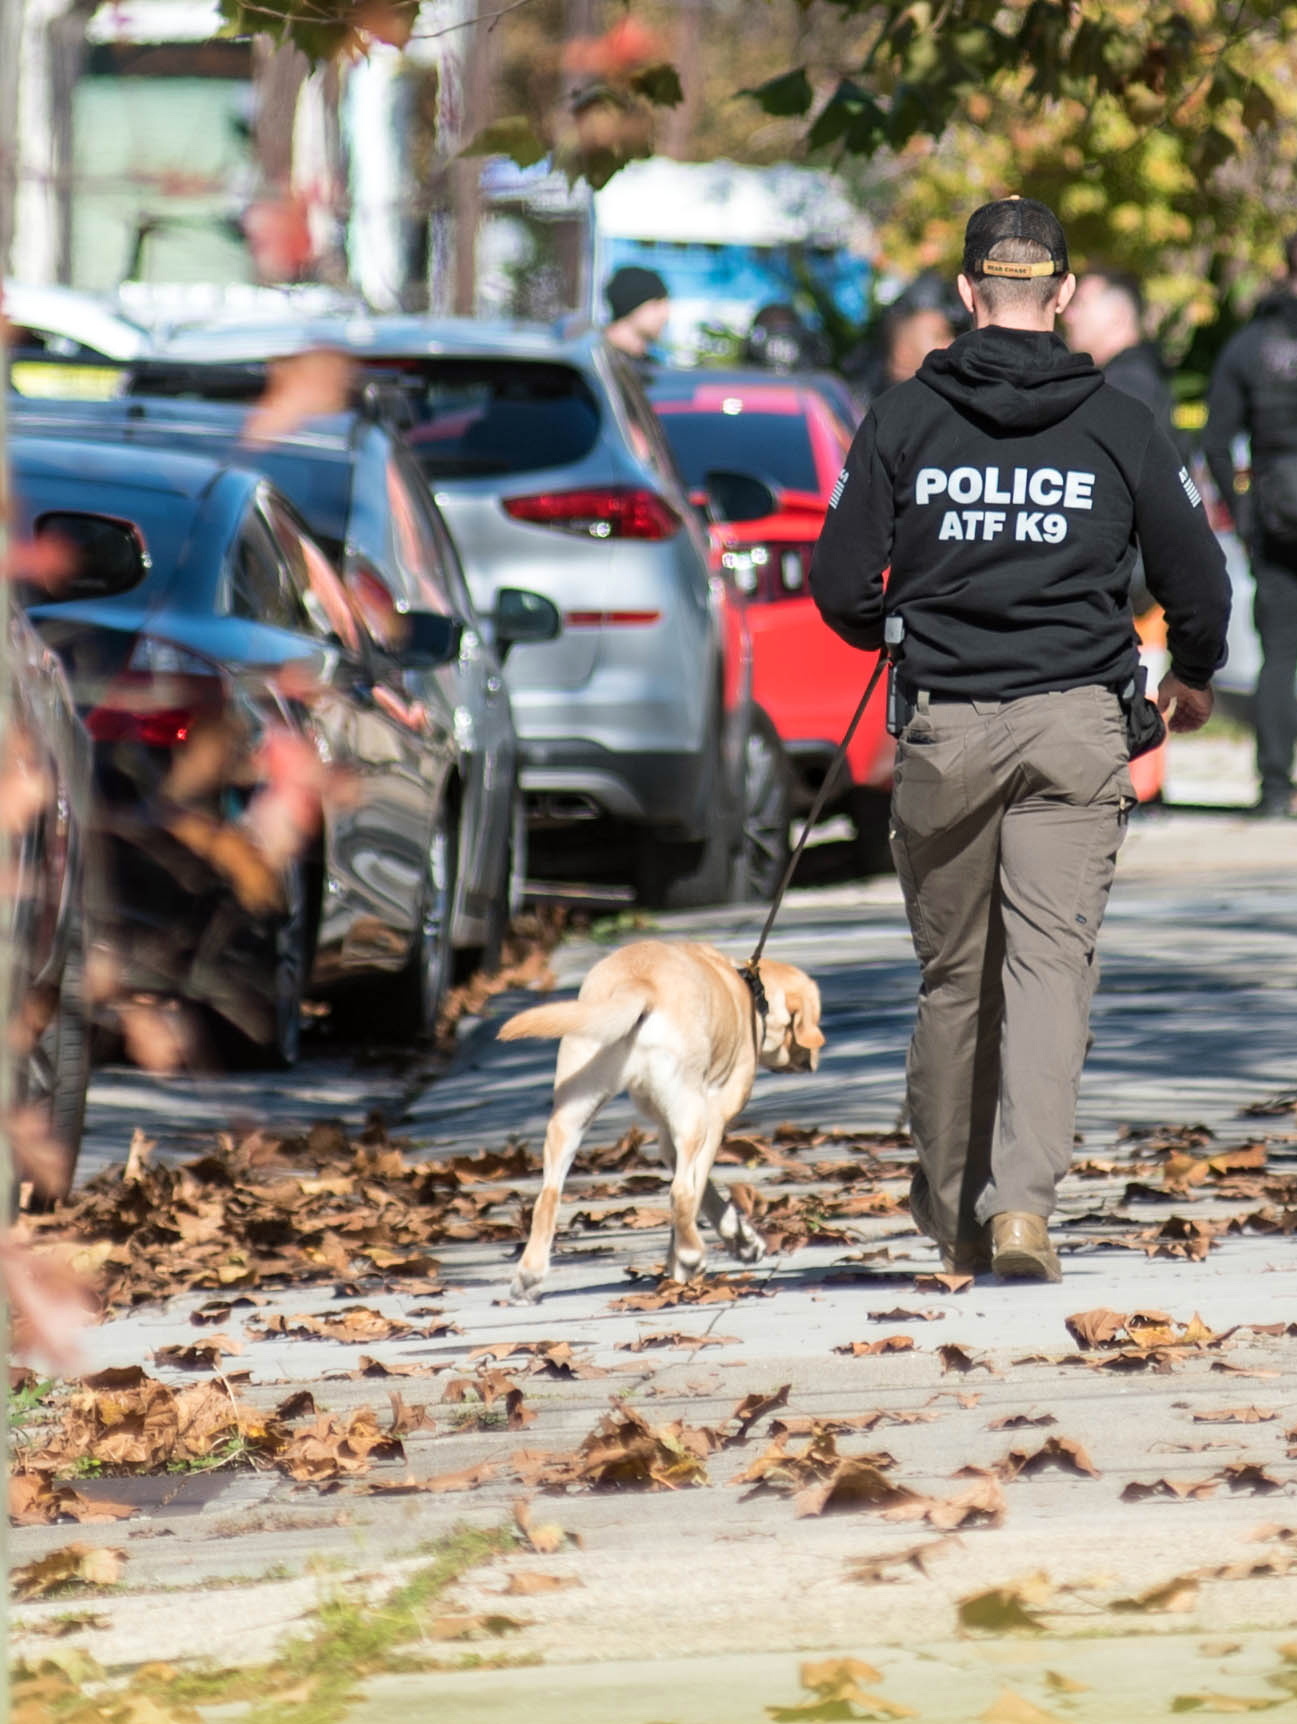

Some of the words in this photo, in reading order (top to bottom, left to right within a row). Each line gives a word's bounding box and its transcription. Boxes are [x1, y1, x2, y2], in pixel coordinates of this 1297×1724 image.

[915, 467, 1096, 510] POLICE
[938, 511, 1006, 541] ATF
[1015, 512, 1068, 544] K9
